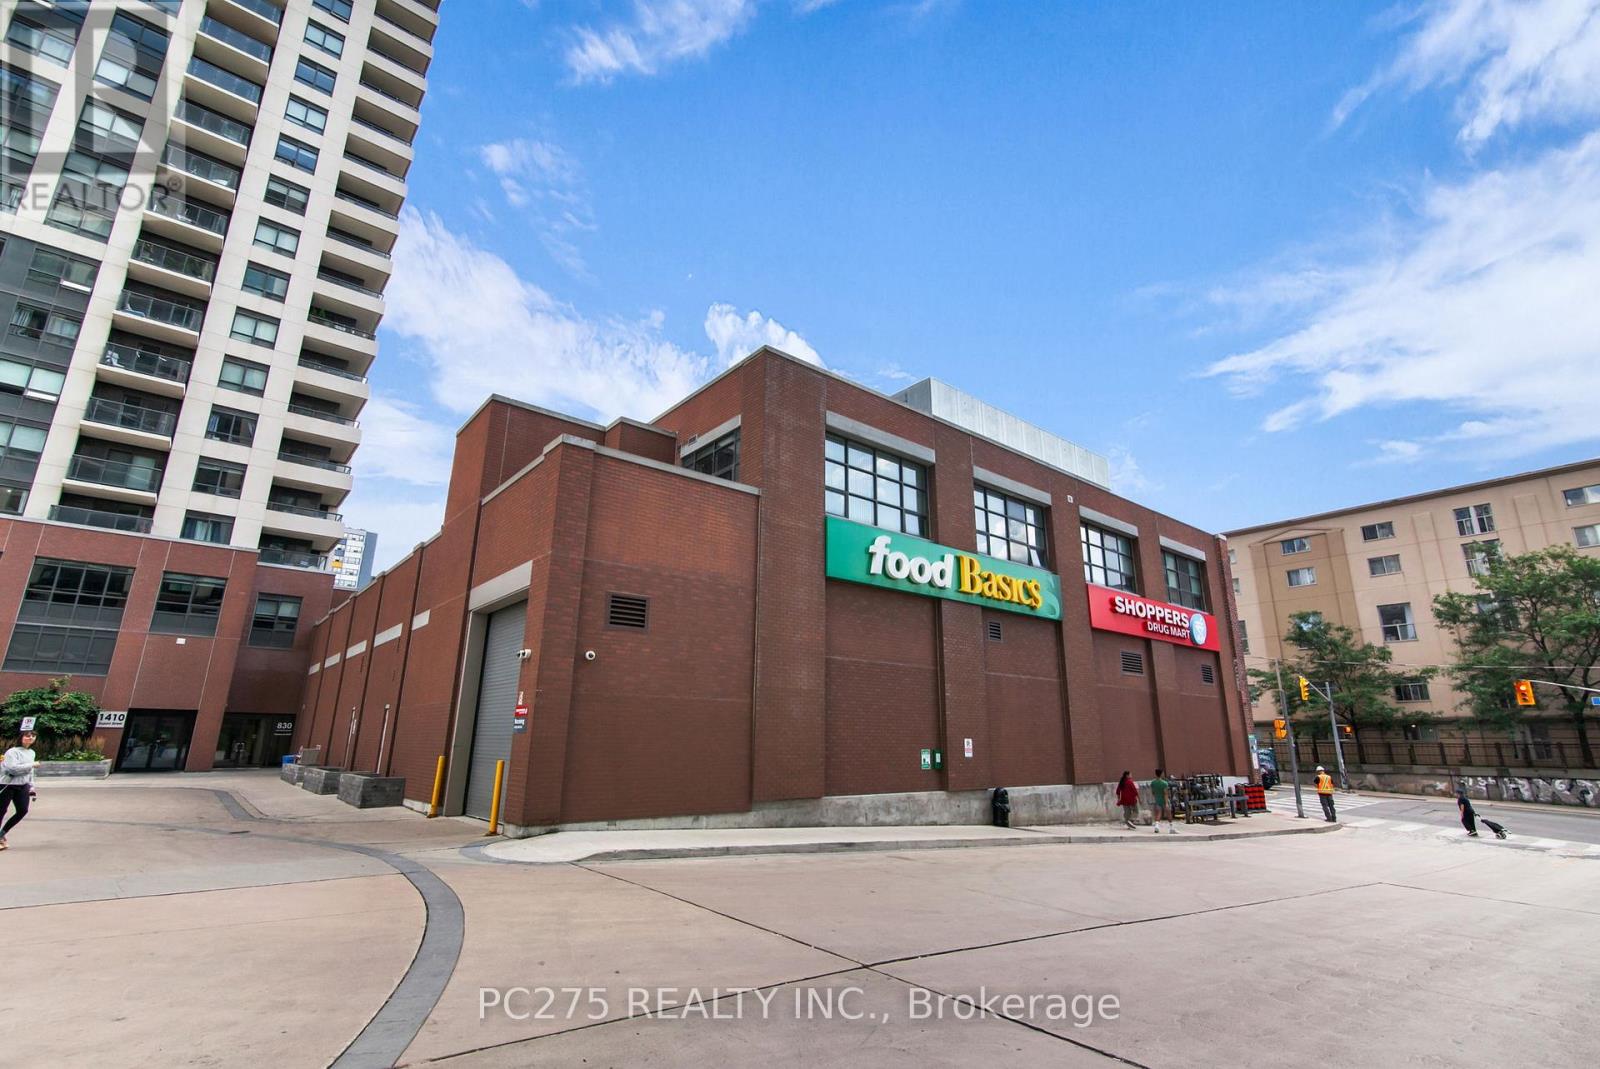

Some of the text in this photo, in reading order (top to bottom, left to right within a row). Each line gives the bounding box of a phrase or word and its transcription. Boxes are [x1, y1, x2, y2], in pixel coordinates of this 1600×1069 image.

[868, 535, 1043, 609] food Basics
[1114, 595, 1190, 629] SHOPPERS
[1147, 621, 1191, 640] DRUG MART
[99, 713, 125, 721] 1410
